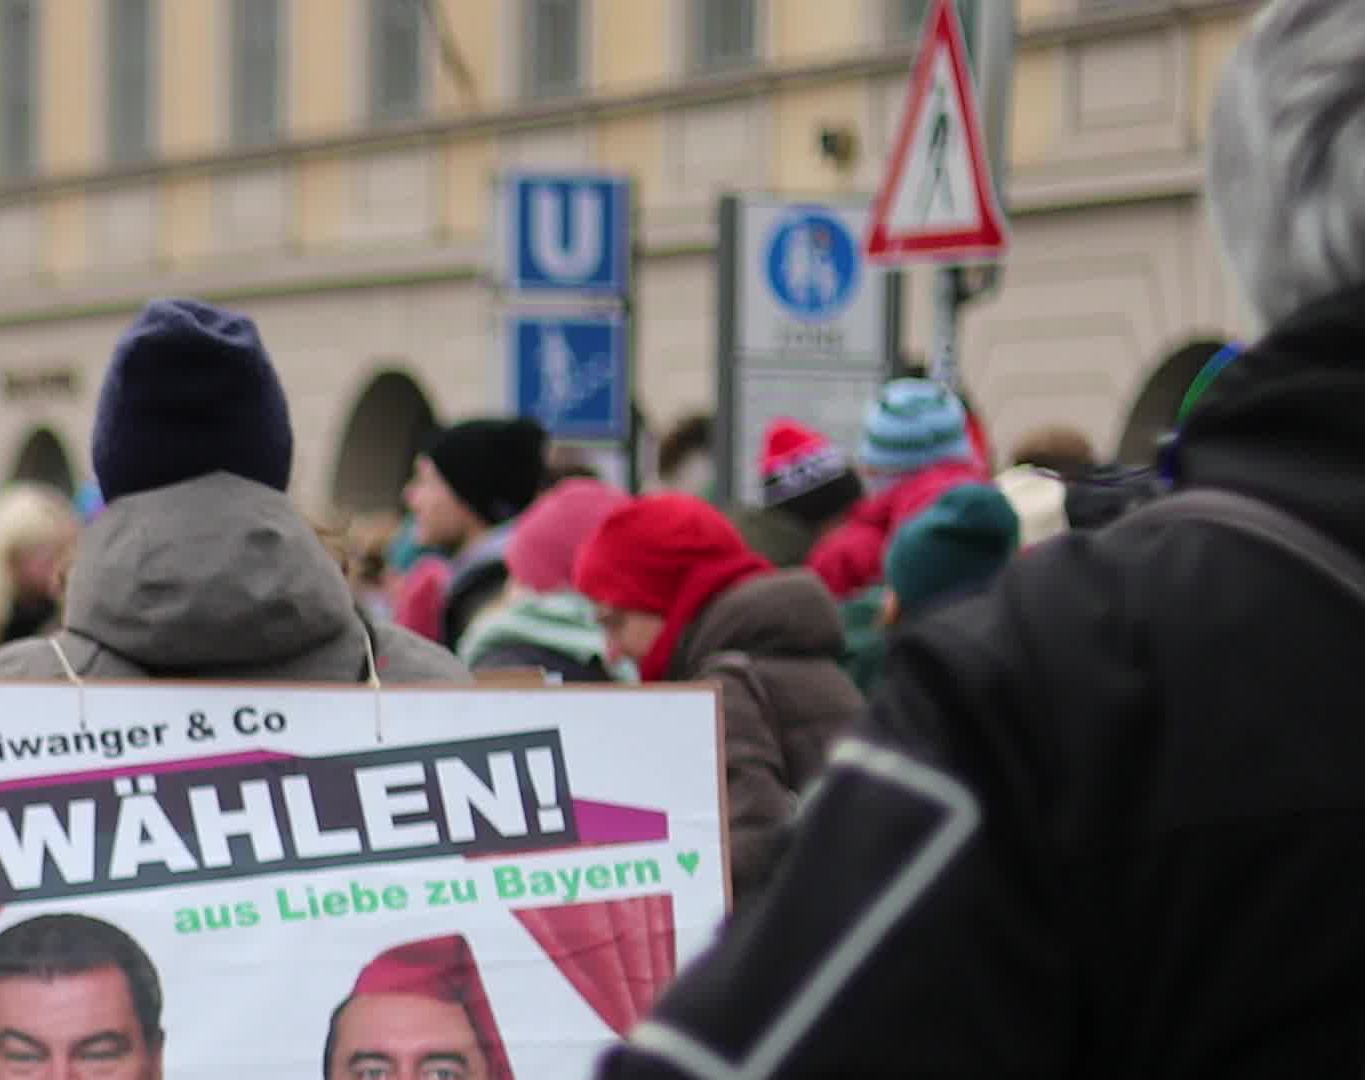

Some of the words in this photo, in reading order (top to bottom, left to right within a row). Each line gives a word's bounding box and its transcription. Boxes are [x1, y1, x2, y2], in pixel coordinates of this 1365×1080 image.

[528, 184, 605, 284] U
[187, 713, 214, 740] &
[233, 707, 286, 735] Co
[175, 896, 261, 935] aus
[277, 882, 406, 921] Liebe
[426, 872, 478, 906] zu
[496, 851, 662, 904] Bayern
